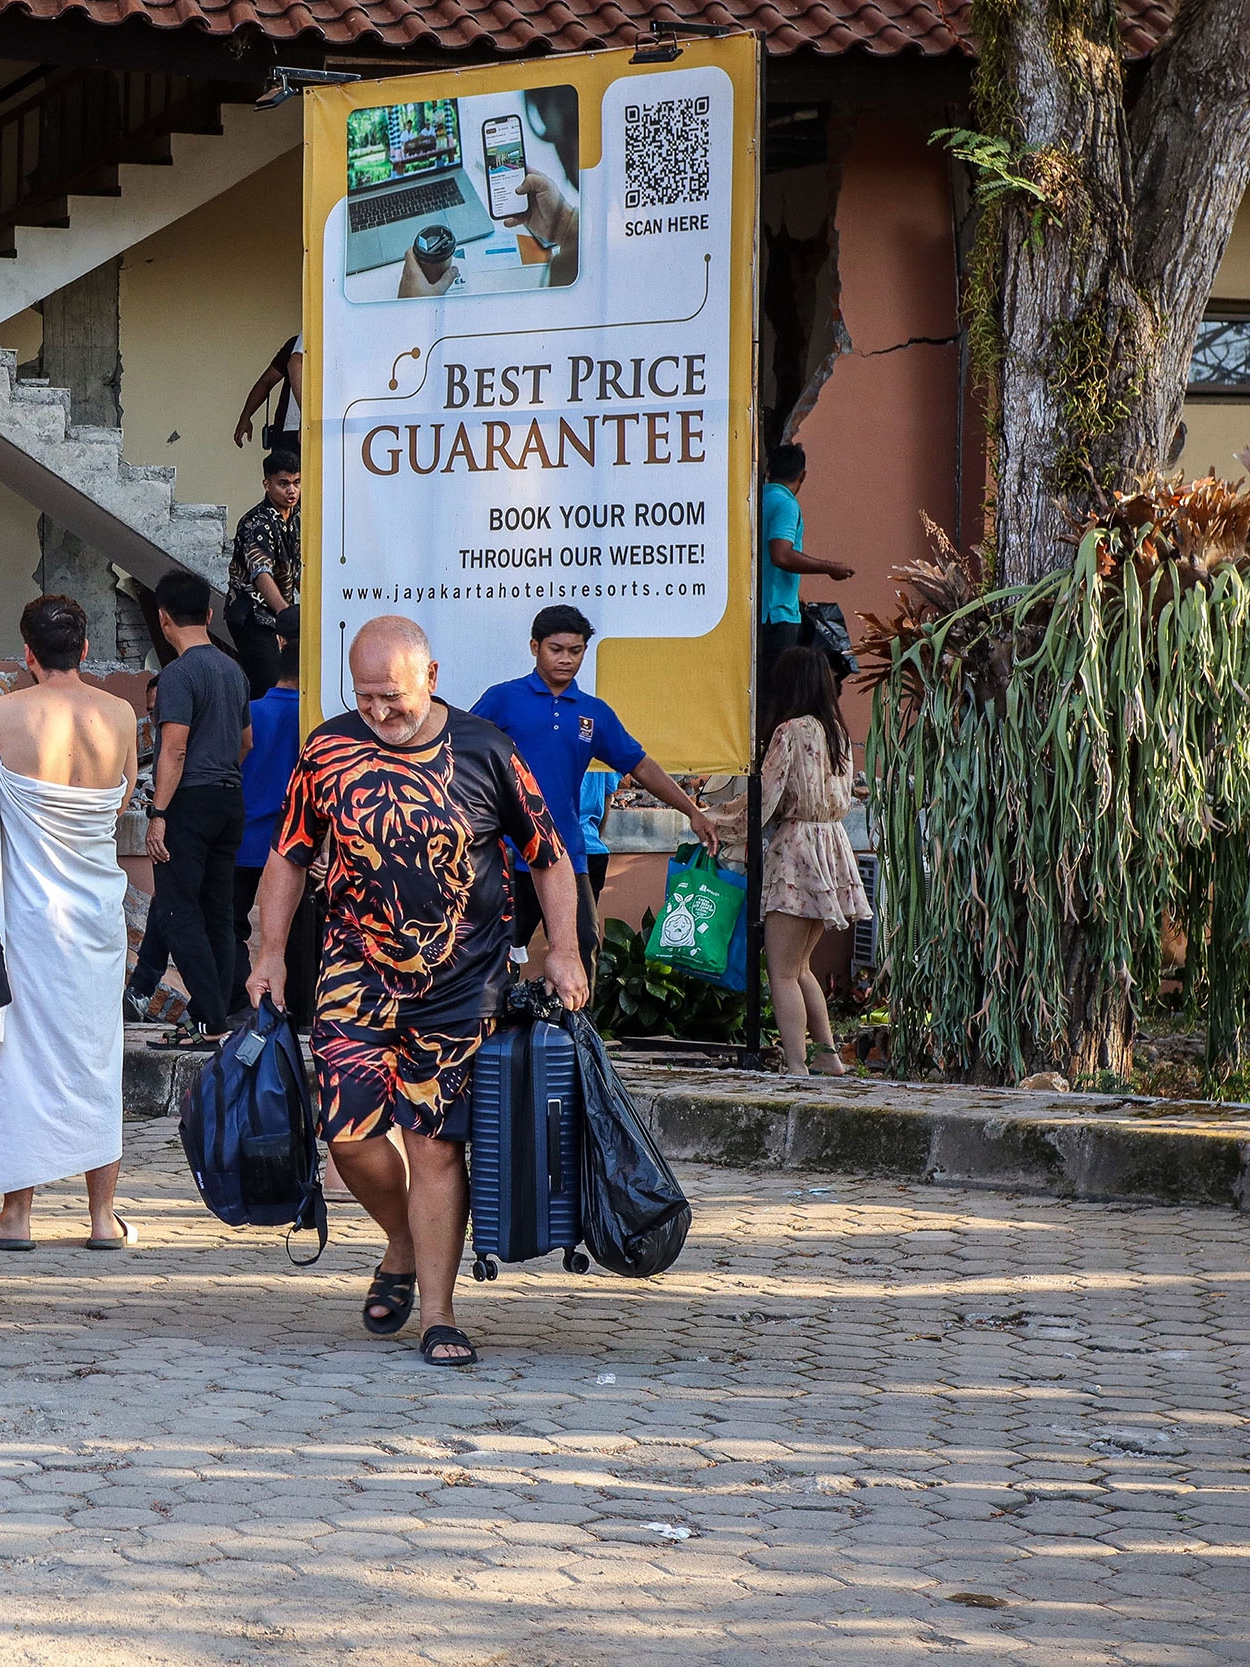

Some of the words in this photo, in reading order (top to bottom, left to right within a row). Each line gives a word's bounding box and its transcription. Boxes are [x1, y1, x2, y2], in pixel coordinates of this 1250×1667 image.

[625, 220, 662, 236] SCAN
[668, 214, 710, 233] HERE
[443, 364, 551, 409] BEST
[567, 354, 706, 402] PRICE
[362, 410, 705, 475] GUARANTEE
[490, 506, 551, 530] BOOK
[560, 504, 625, 528] YOUR
[635, 502, 704, 526] ROOM
[459, 548, 551, 568] THROUGH
[561, 546, 602, 567] OUR
[610, 543, 704, 566] WEBSITE!
[343, 580, 706, 602] www.jayakartahotelsresorts.com
